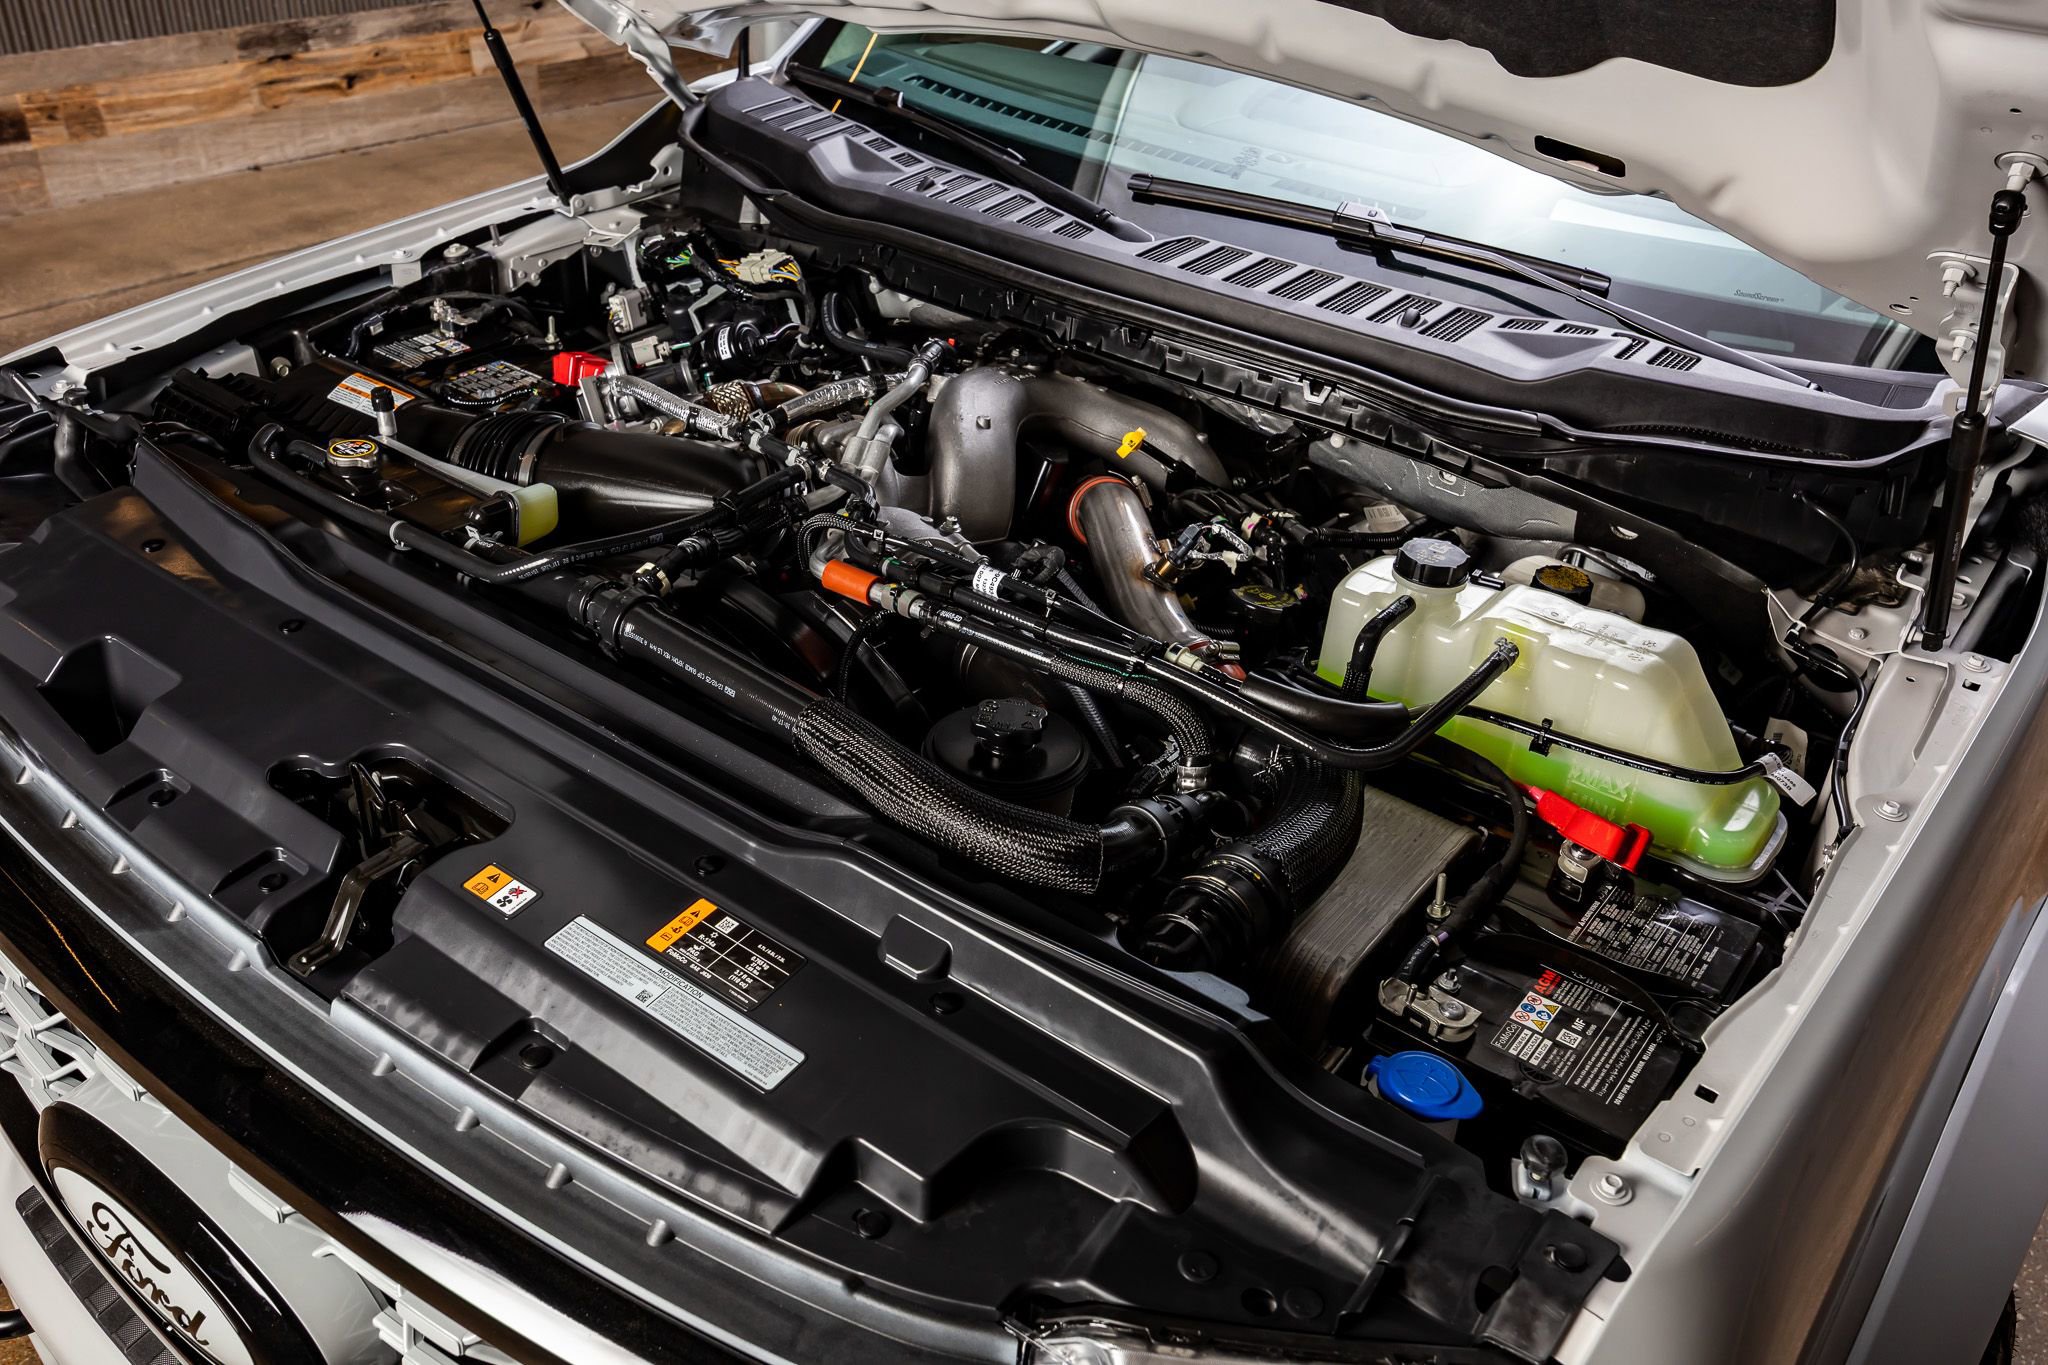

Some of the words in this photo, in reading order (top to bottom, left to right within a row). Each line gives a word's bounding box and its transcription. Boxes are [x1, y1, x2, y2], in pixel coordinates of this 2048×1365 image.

[697, 933, 718, 947] R-134a
[665, 948, 689, 964] FoMoCo
[686, 947, 700, 956] PAG
[657, 967, 704, 999] MODIFICATION
[1531, 968, 1557, 994] AGM
[1570, 1016, 1587, 1031] MF
[1494, 1021, 1518, 1048] FoMoCo
[86, 1202, 210, 1346] Ford
